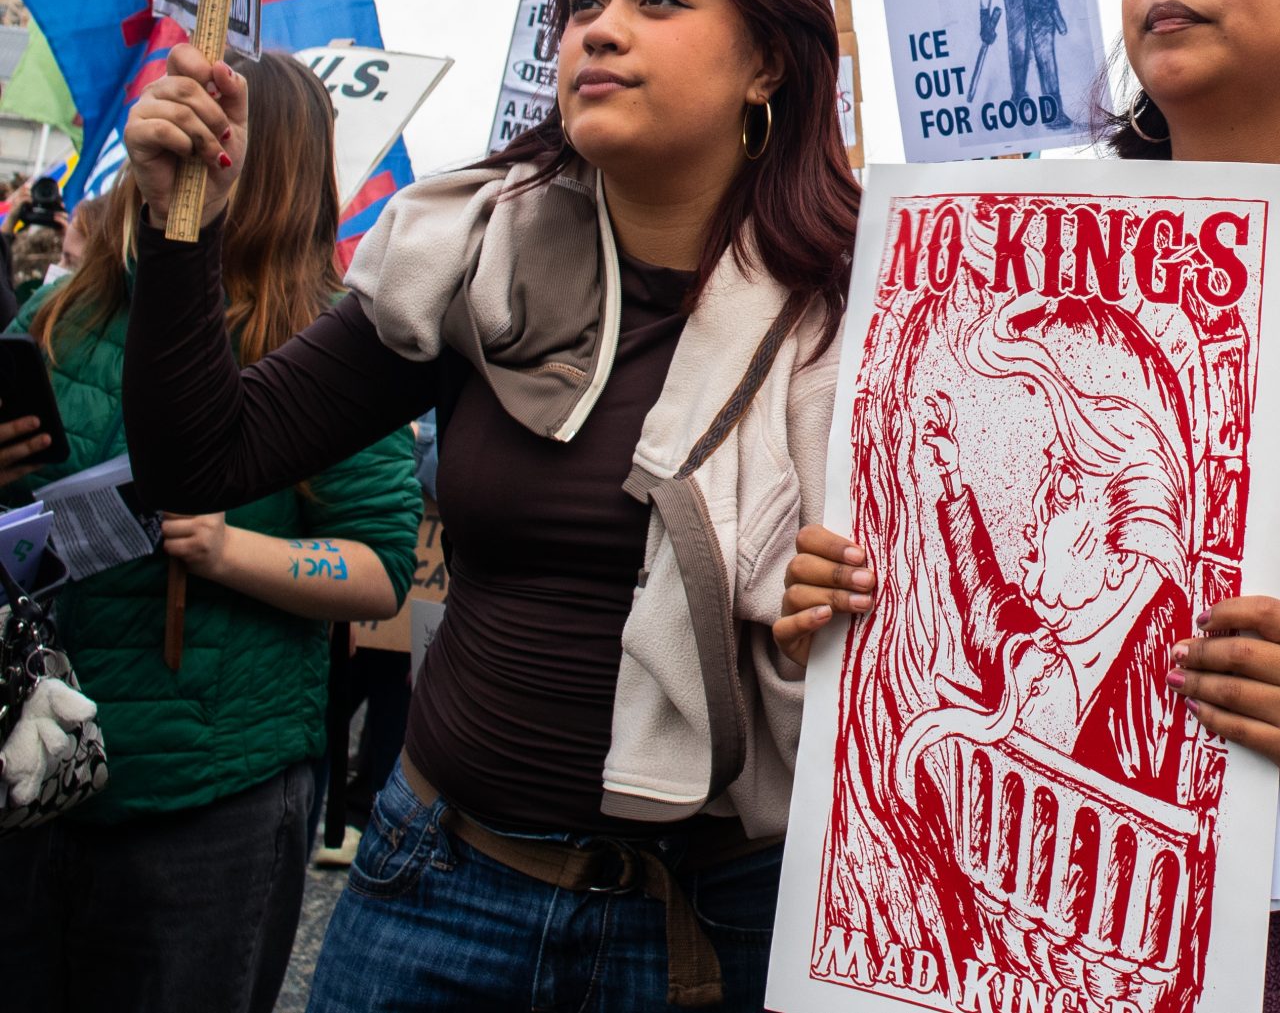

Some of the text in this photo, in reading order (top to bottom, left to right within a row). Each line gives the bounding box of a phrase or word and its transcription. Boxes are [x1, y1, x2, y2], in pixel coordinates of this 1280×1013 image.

[909, 30, 950, 62] ICE
[915, 67, 966, 100] OUT
[920, 95, 1058, 139] FOR GOOD
[884, 204, 1250, 307] NO KINGS
[288, 555, 348, 580] FUCK
[812, 926, 940, 994] MAD
